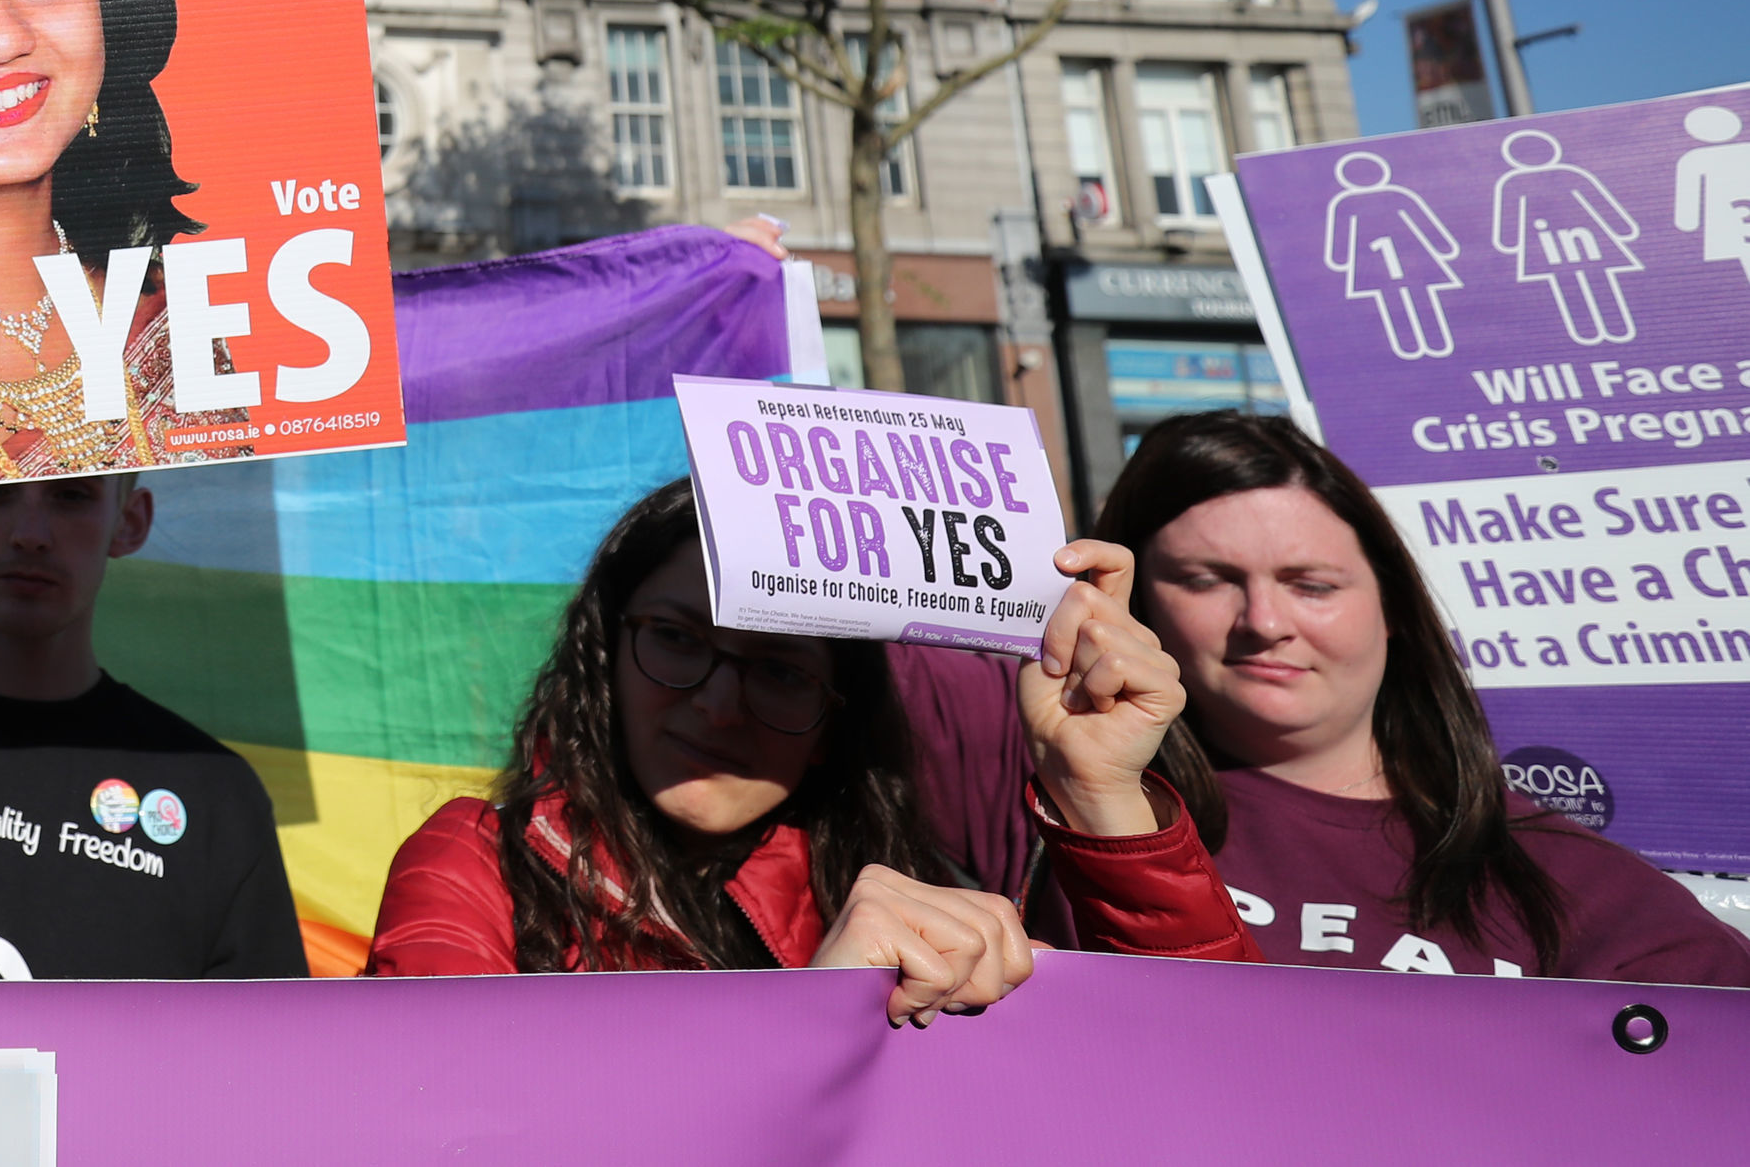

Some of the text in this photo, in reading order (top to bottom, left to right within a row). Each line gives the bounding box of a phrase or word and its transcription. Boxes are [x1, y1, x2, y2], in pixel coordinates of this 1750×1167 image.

[270, 177, 362, 217] Vote
[1369, 236, 1405, 282] 1
[1533, 218, 1604, 266] in
[1102, 269, 1248, 297] CURRENC
[32, 228, 372, 425] YES
[1472, 362, 1583, 406] Will
[1590, 360, 1725, 398] Face
[170, 411, 381, 447] www.rosa.ie 0876418519
[757, 399, 966, 436] Repeal Referendum 25 May
[1411, 411, 1558, 454] Crisis
[726, 420, 1030, 514] ORGANISE
[1419, 486, 1747, 546] Make Sure
[774, 493, 1013, 591] FOR YES
[751, 570, 1047, 624] Organise for Choice, Freedom & Equality
[1460, 558, 1617, 608] Have
[1632, 563, 1674, 602] a
[924, 631, 943, 641] now
[1536, 634, 1569, 668] a
[1500, 763, 1605, 797] ROSA
[58, 822, 165, 878] Freedom
